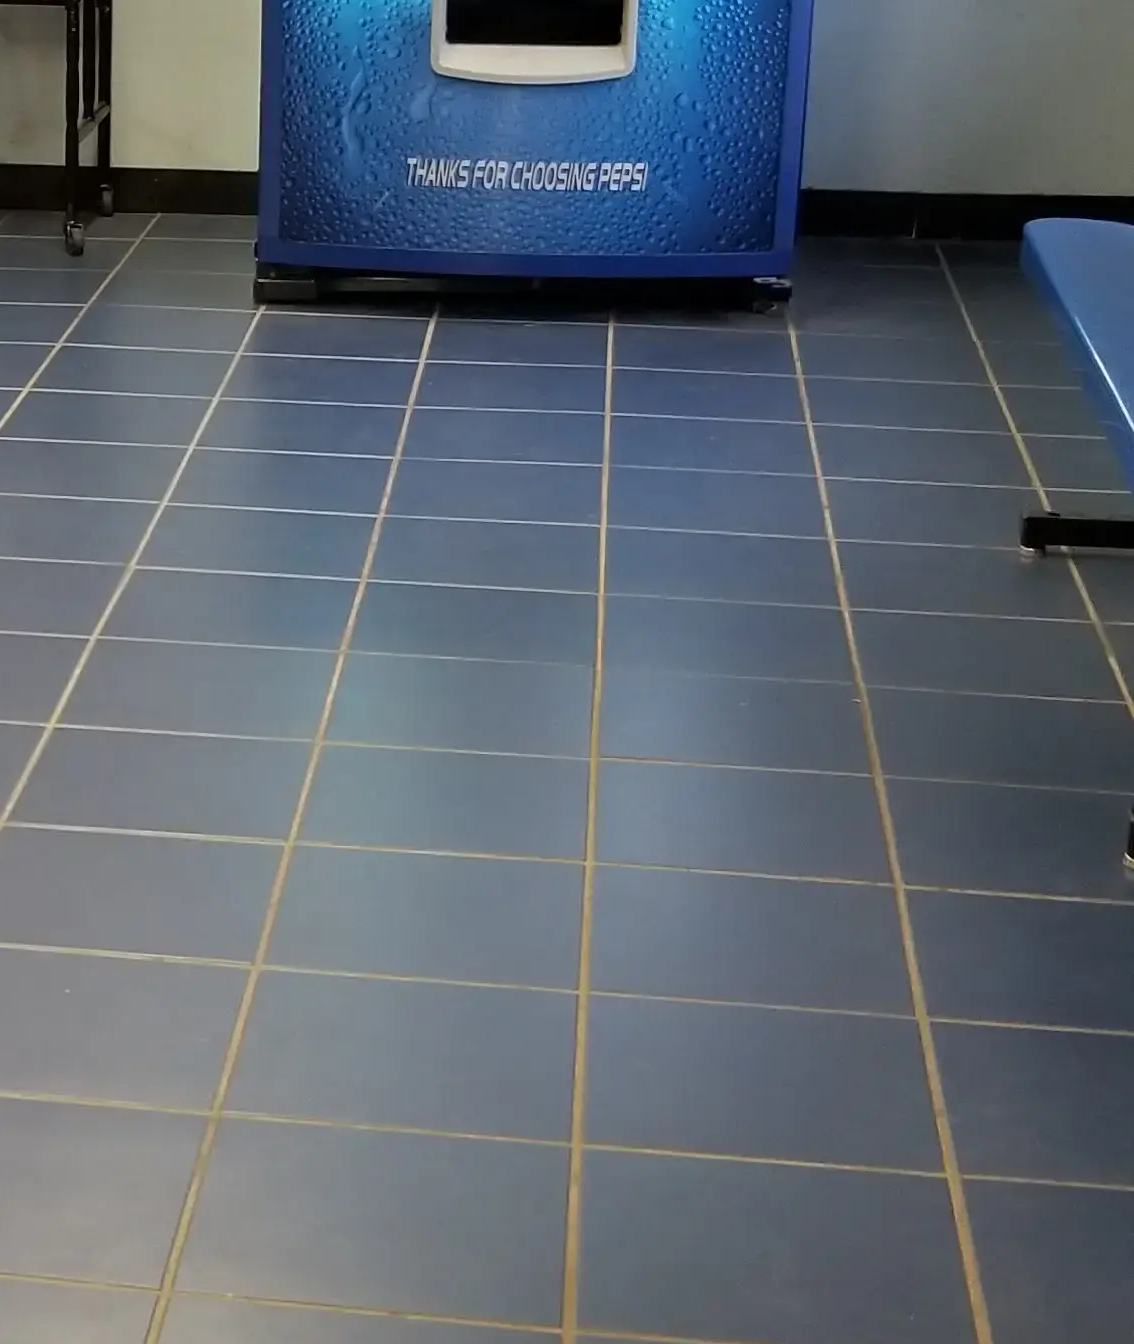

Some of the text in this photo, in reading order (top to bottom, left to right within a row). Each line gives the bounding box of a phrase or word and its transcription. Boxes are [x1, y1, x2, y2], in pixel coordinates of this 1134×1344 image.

[406, 157, 649, 192] THANKS FOR CHOOSING PEPSI
